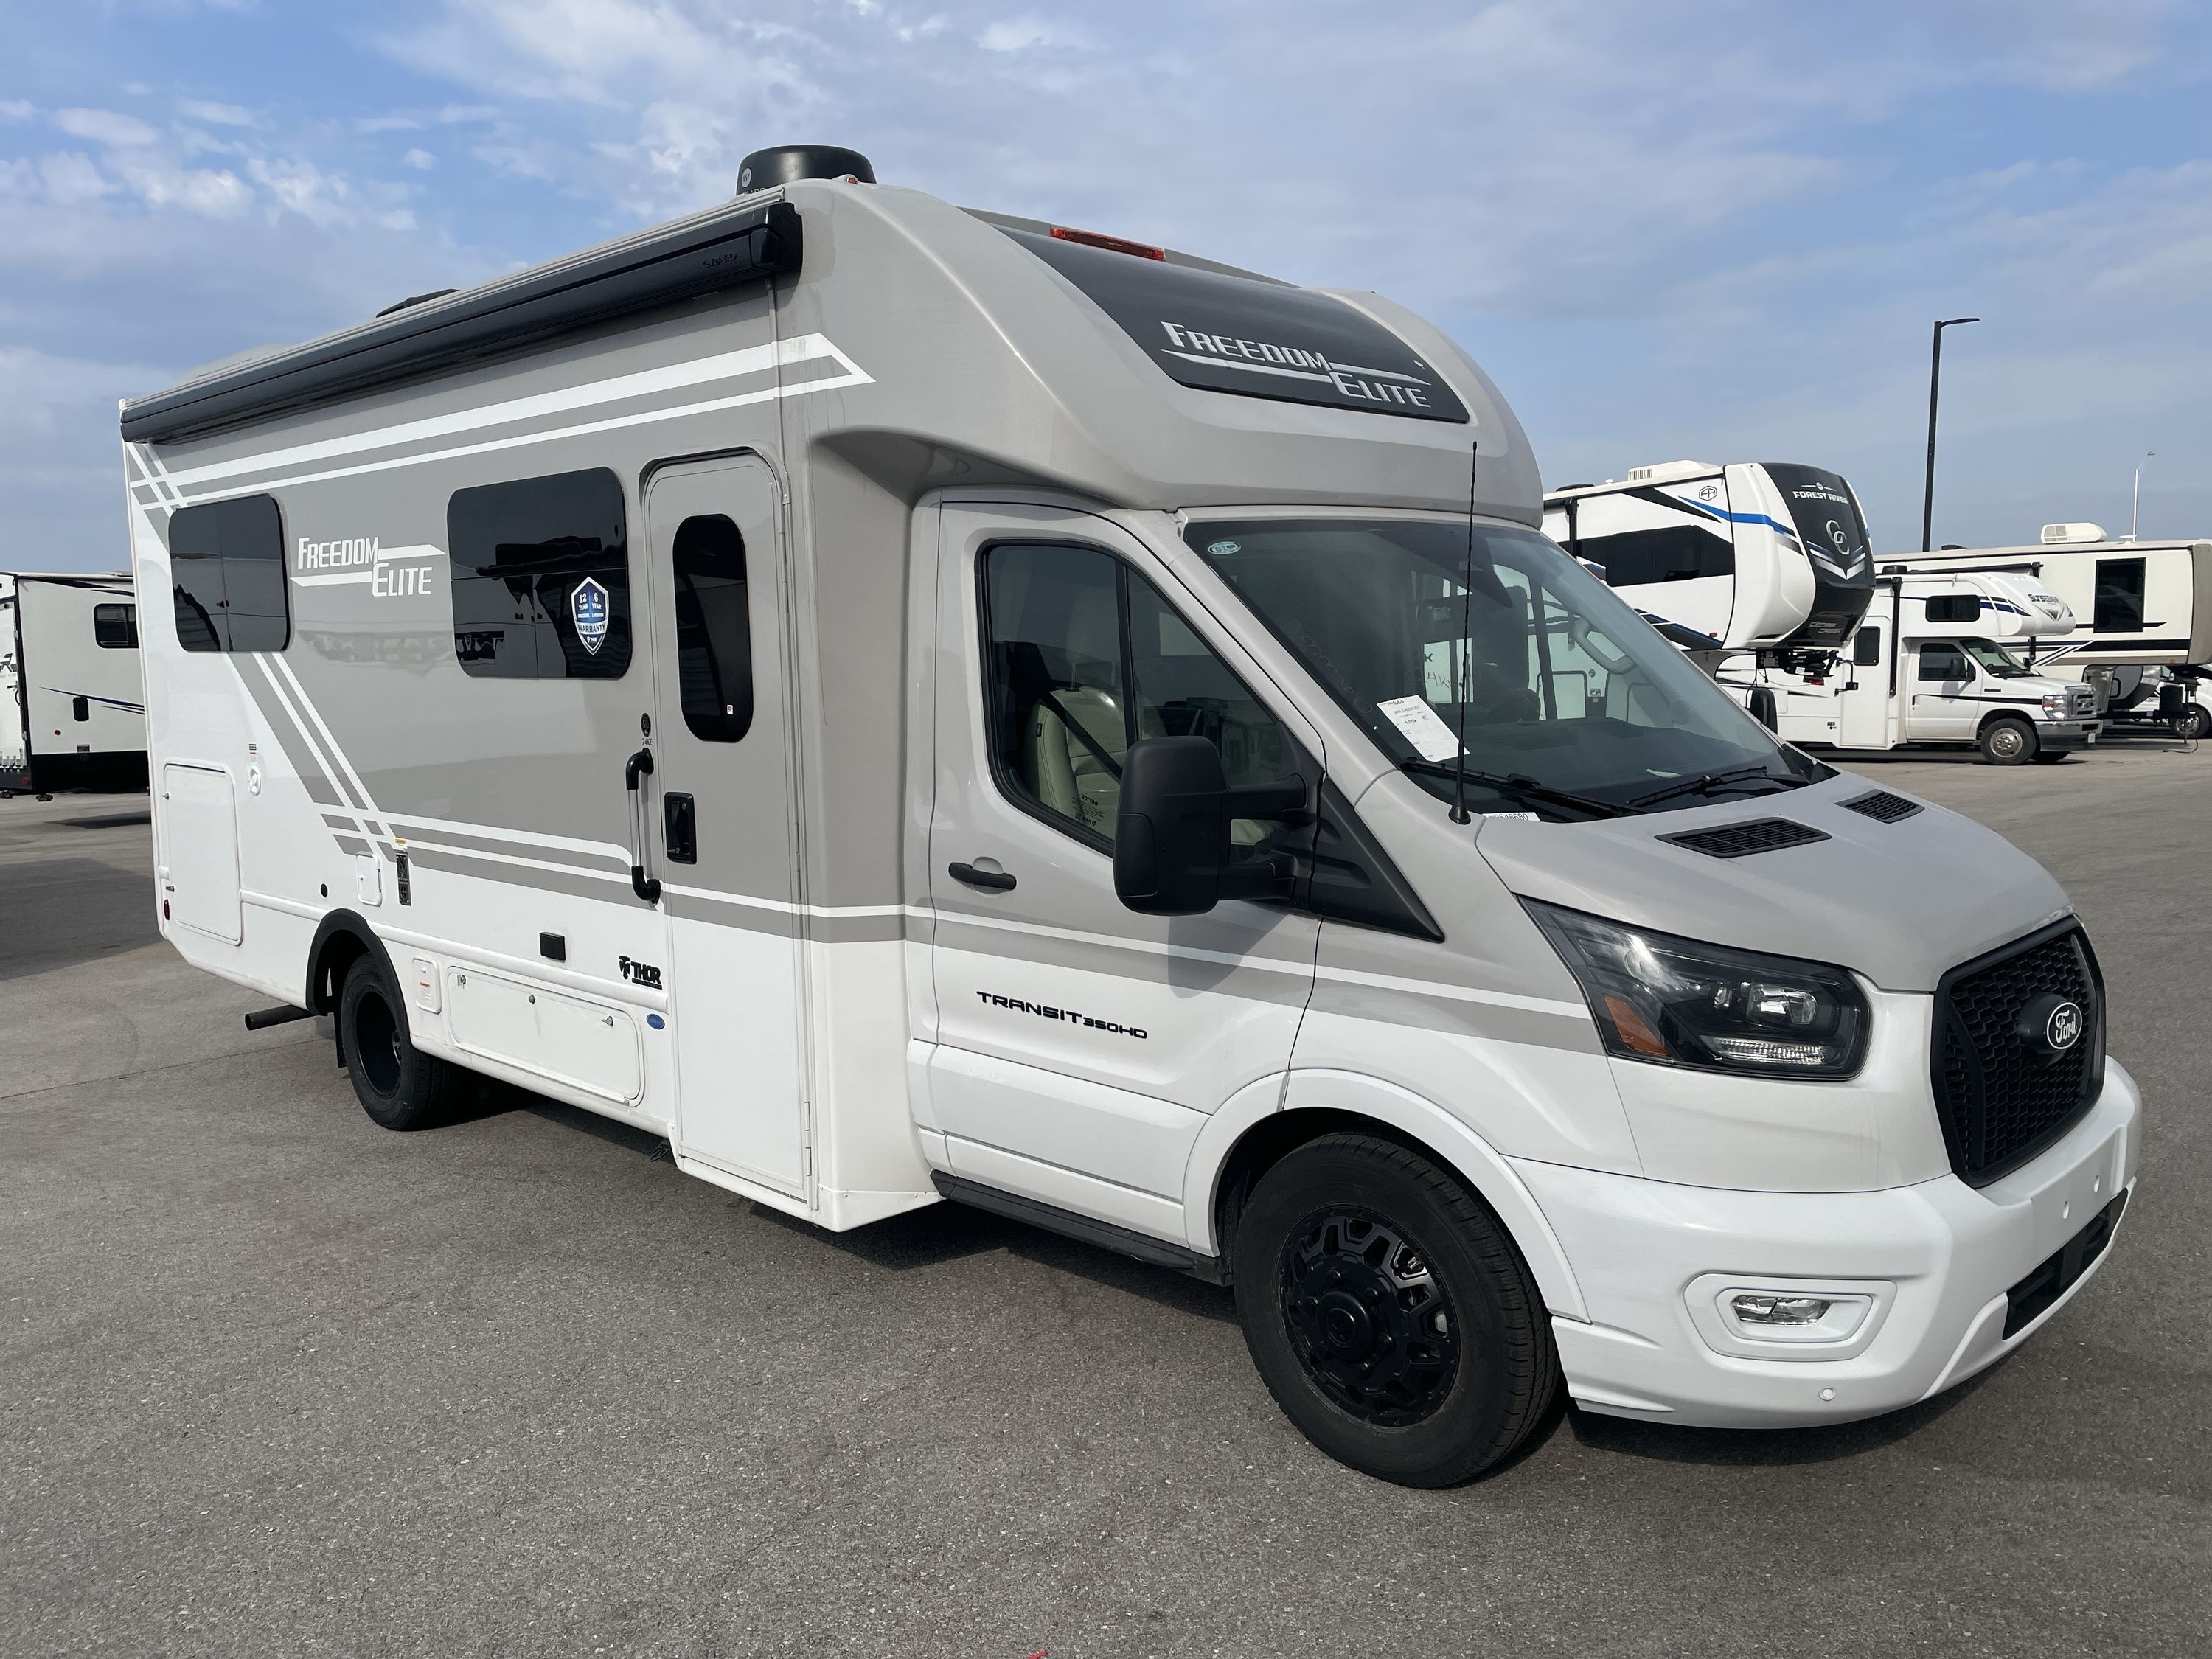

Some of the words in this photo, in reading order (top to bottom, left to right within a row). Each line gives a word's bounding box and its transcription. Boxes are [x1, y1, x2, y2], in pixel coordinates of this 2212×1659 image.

[1161, 321, 1332, 372] FREEDOM
[1329, 370, 1432, 408] ELITE
[1792, 491, 1827, 499] FOREST
[1828, 493, 1848, 505] RIVER
[297, 537, 379, 569] FREEDOM
[372, 563, 433, 597] ELITE
[579, 592, 587, 604] 12
[594, 592, 599, 602] 6
[578, 624, 605, 633] WARRANTY
[631, 961, 662, 985] THOR
[2056, 1009, 2078, 1044] Ford
